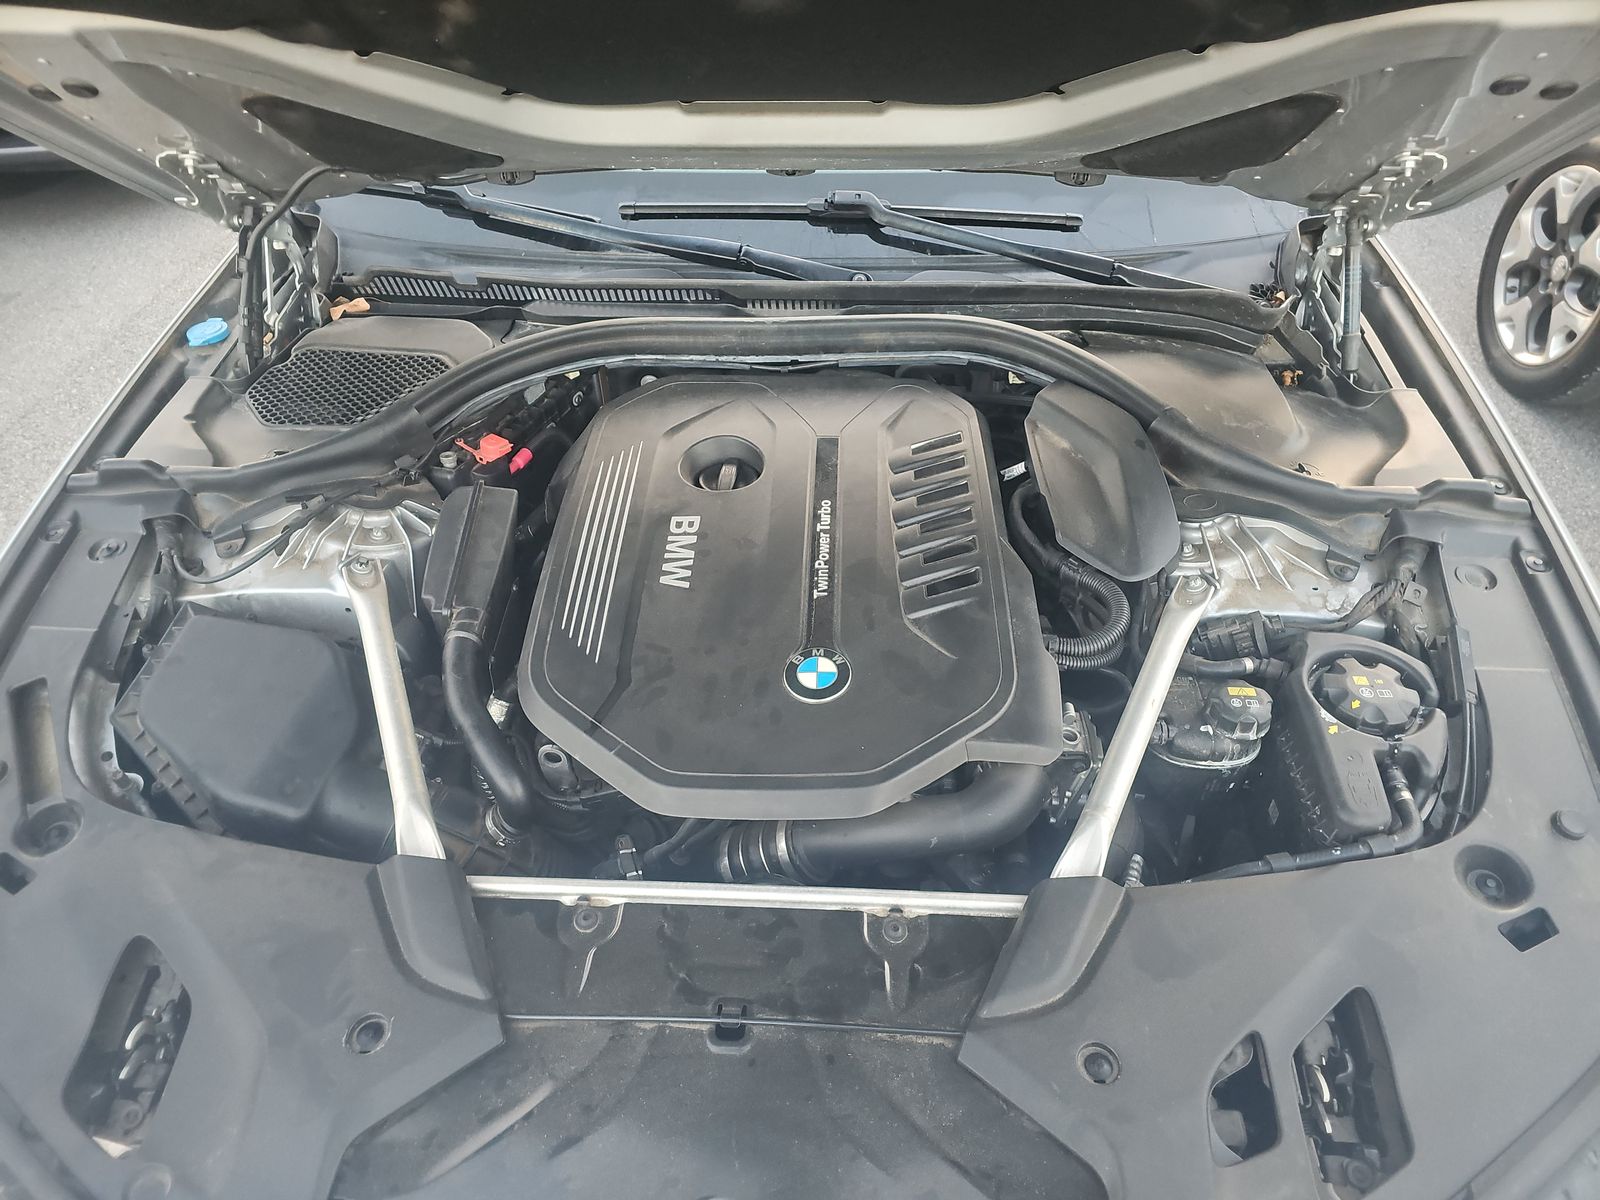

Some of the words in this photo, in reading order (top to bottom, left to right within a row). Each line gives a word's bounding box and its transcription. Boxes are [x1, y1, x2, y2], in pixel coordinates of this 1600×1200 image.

[816, 499, 832, 531] Turbo
[659, 515, 700, 588] BMW
[813, 532, 830, 599] TwinPower
[791, 649, 845, 665] BMW
